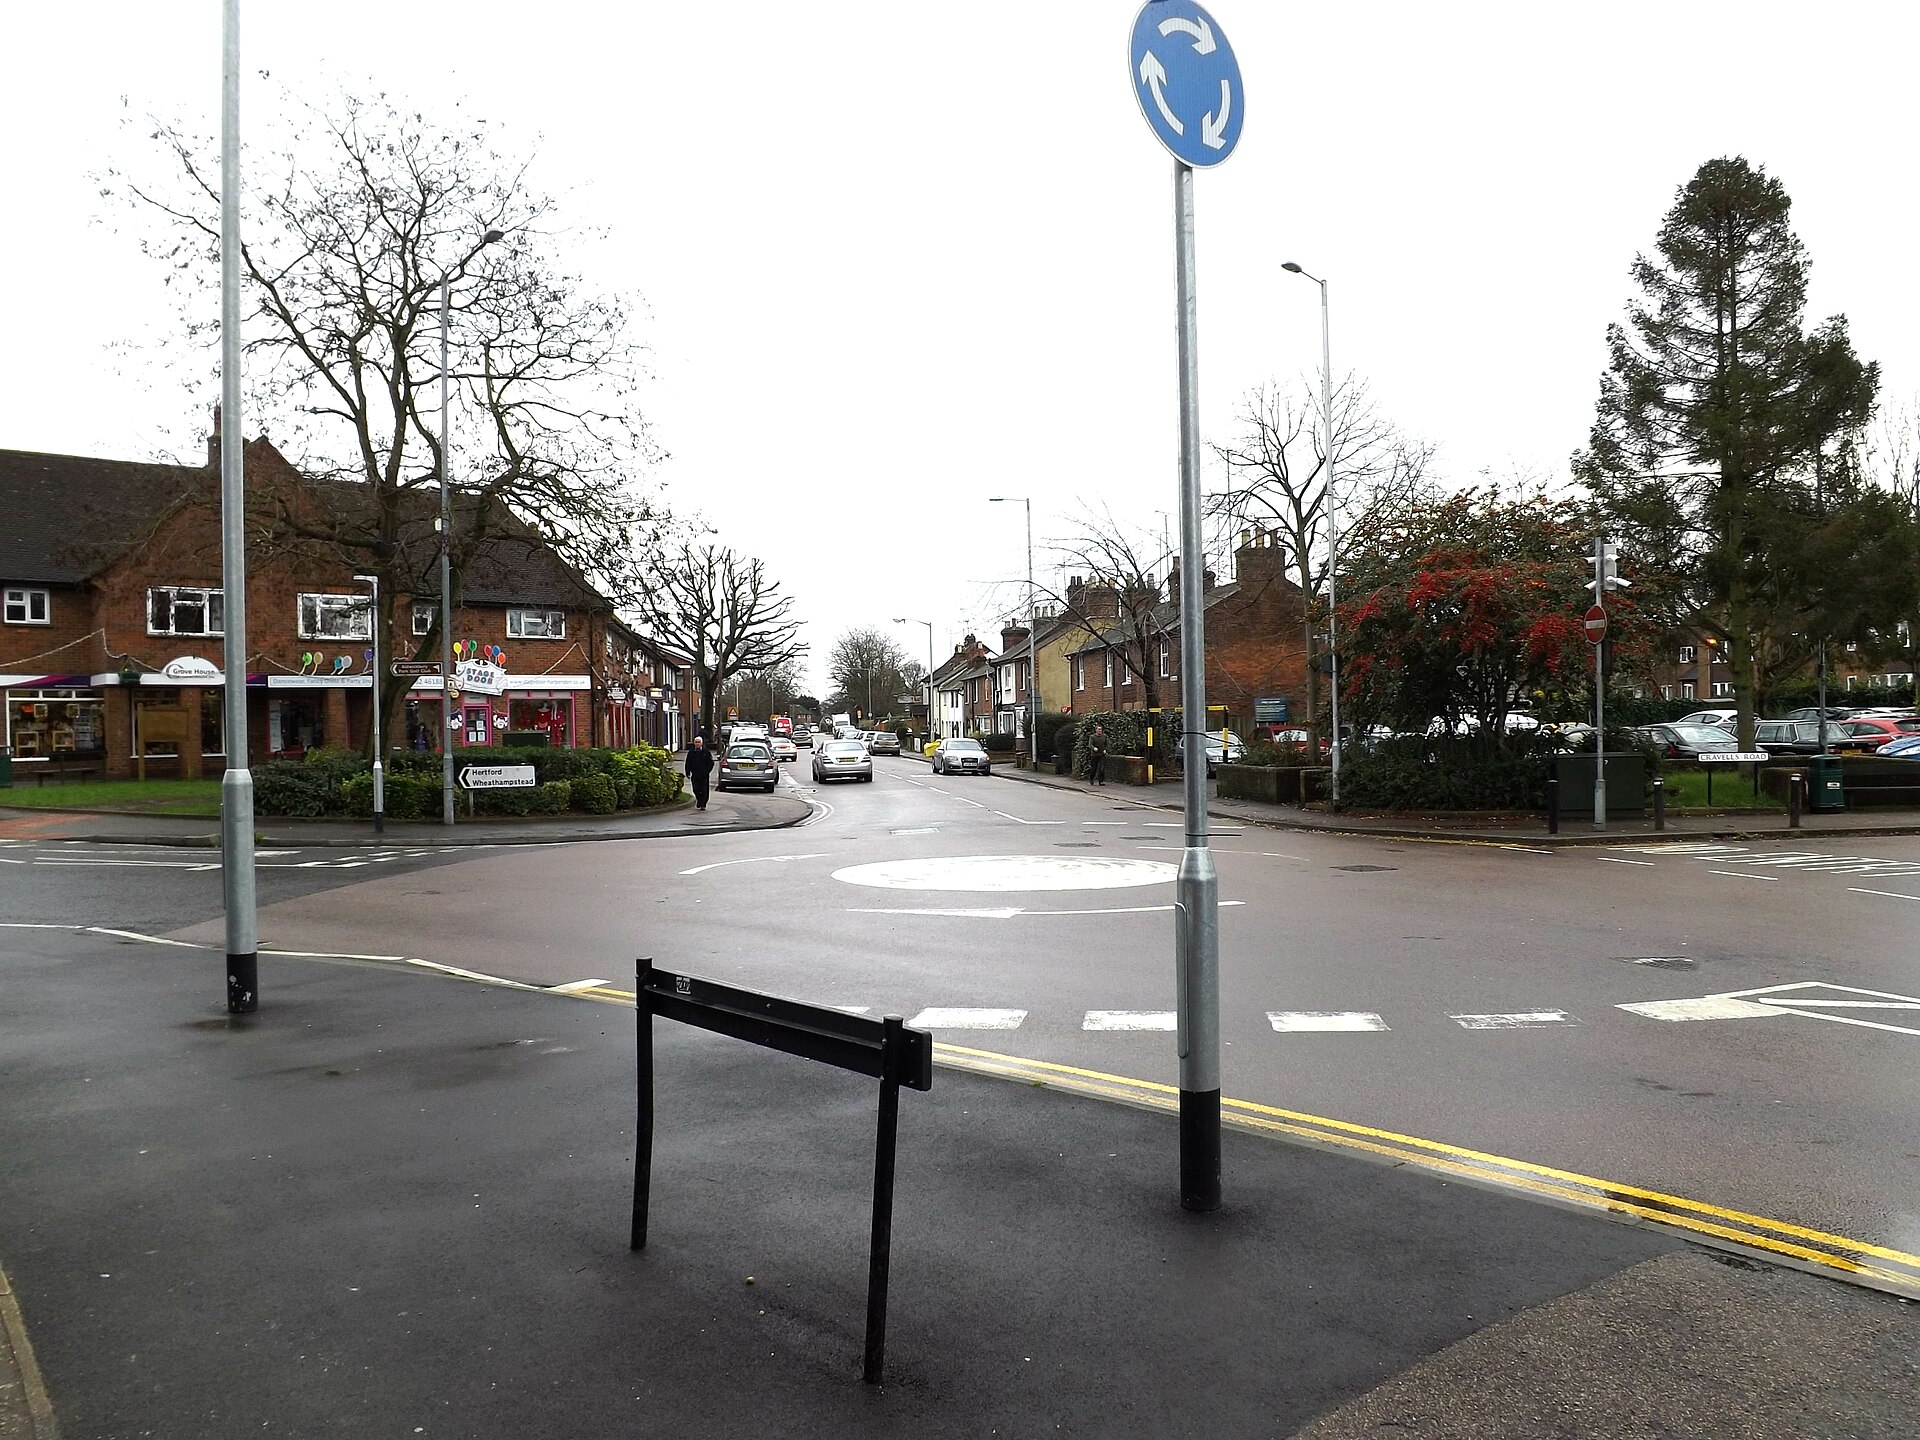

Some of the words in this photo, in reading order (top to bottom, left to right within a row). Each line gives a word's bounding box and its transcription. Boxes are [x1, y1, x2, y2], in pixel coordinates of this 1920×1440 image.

[466, 667, 495, 678] STAGE
[467, 675, 493, 684] DOOR
[472, 778, 534, 787] Wheathampstead
